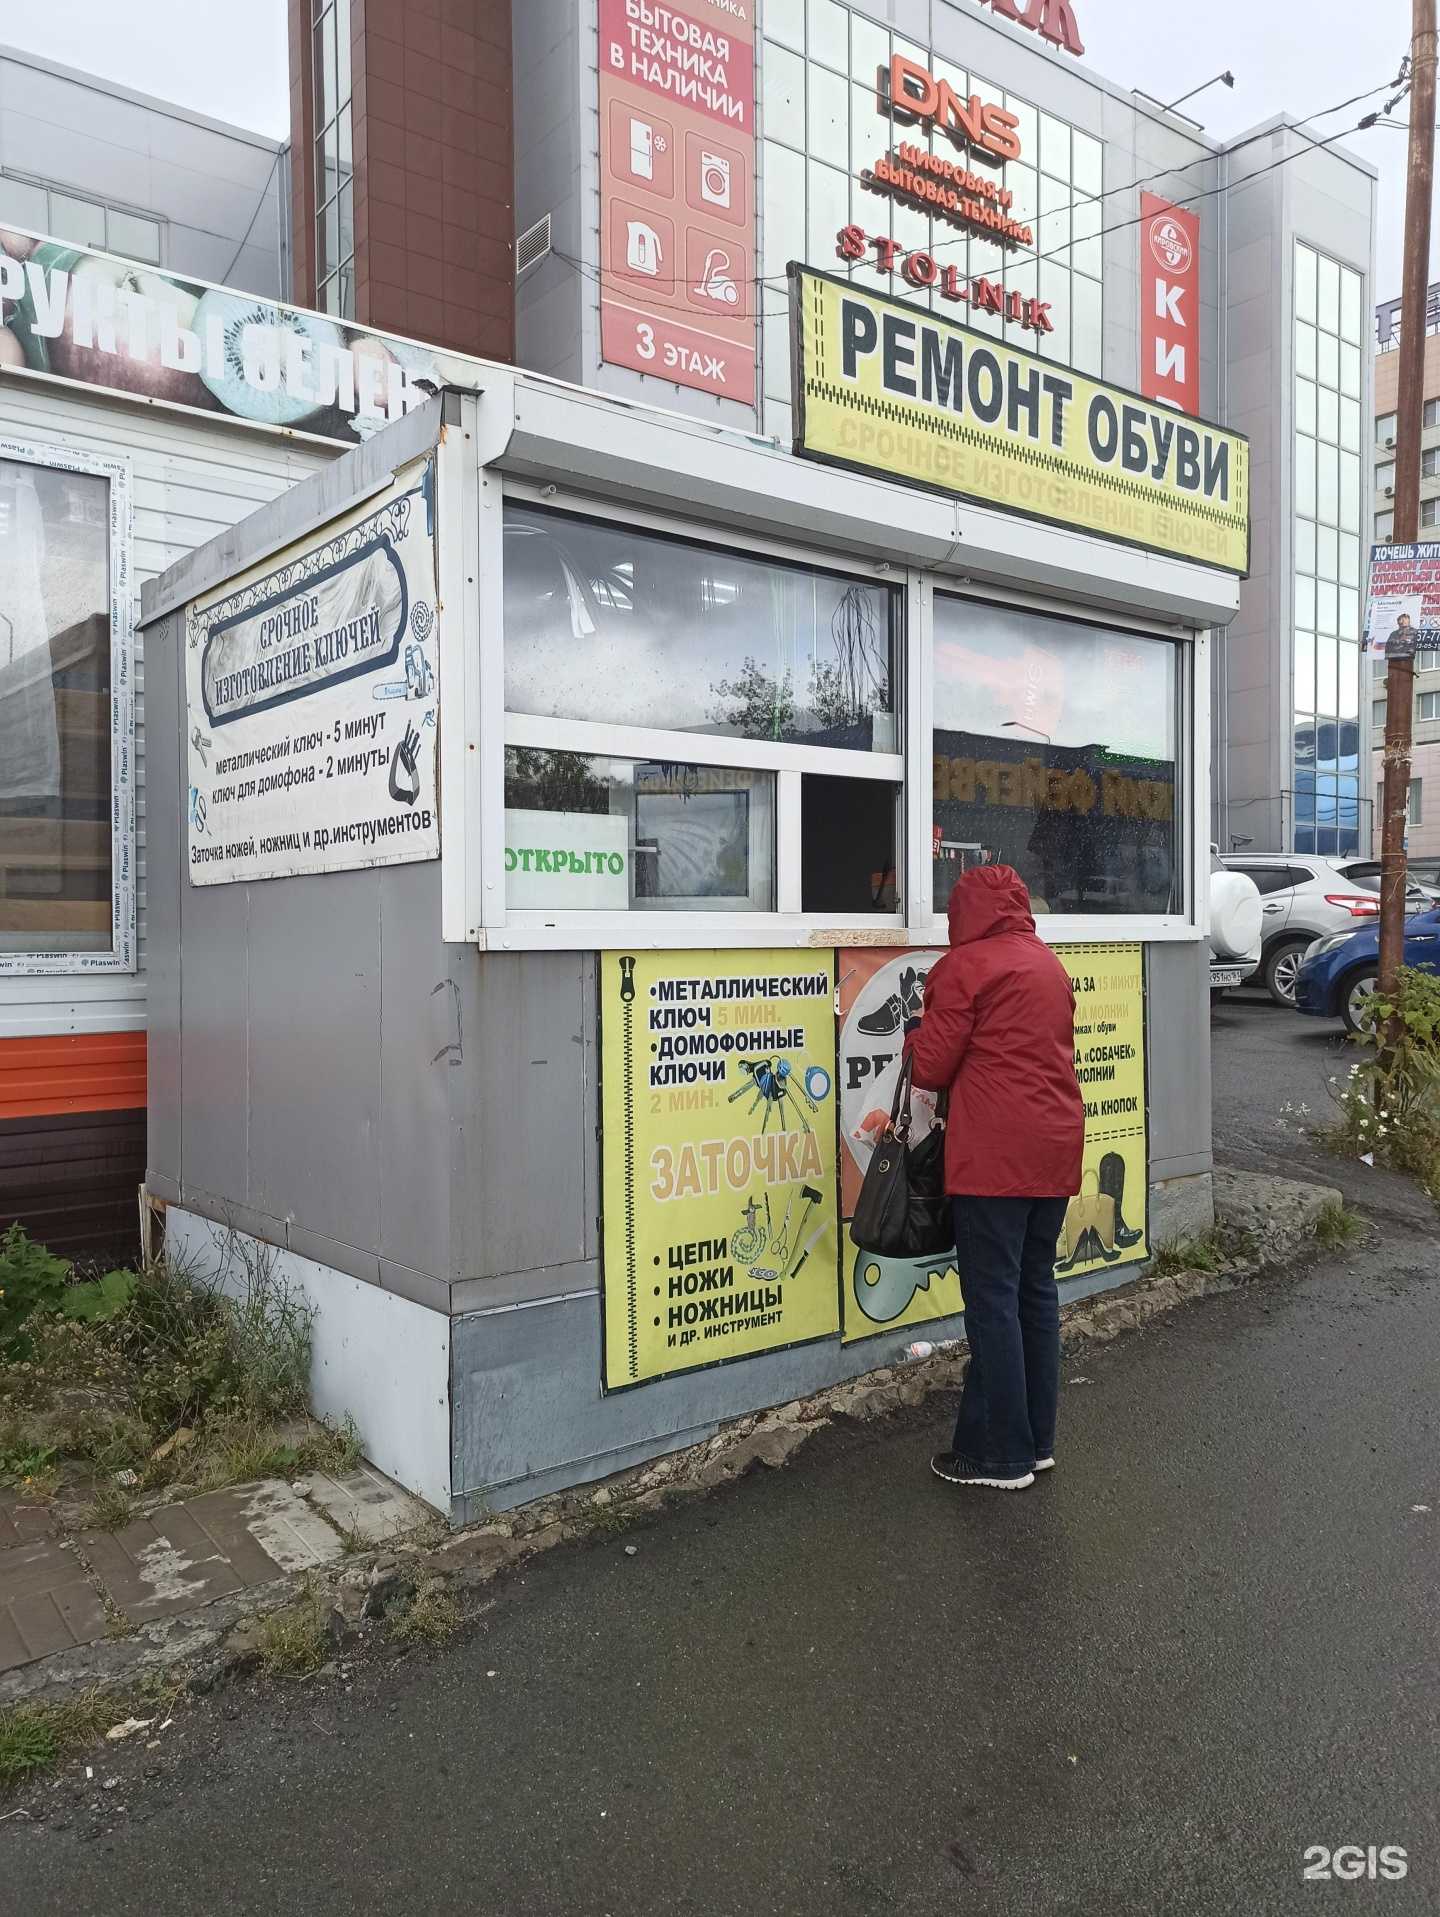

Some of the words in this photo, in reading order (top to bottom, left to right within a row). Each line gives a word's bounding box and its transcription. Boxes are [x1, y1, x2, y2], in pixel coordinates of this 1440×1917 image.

[707, 0, 746, 20] НИКА
[625, 0, 729, 62] БЫТОВАЯ
[627, 22, 728, 88] ТЕХНИКА
[610, 42, 625, 69] В
[632, 52, 743, 122] НАЛИЧИИ
[891, 53, 1022, 160] DNS
[899, 141, 996, 197] ЦИФРОВАЯ
[999, 186, 1012, 208] И
[875, 159, 958, 209] БЫТОВАЯ
[961, 197, 1033, 246] ТЕХНИКА
[839, 223, 1054, 332] STOLNIK
[636, 323, 656, 360] 3
[664, 342, 726, 383] ЭТАЖ
[1155, 277, 1187, 412] КИ
[842, 298, 1073, 448] РЕМОНТ
[1087, 394, 1229, 501] ОБУВИ
[836, 418, 965, 481] СРОЧНОЕ
[1374, 545, 1415, 560] ХОЧЕШЬ
[1416, 543, 1440, 558] ЖИТ
[259, 595, 319, 649] СРОЧНОЕ
[215, 644, 310, 706] ИЗГОТОВЛЕНИЕ
[314, 606, 382, 668] КЛЮЧЕЙ
[215, 736, 290, 775] металлический
[293, 731, 323, 755] ключ
[334, 720, 341, 743] 5
[345, 711, 386, 740] минут
[212, 785, 235, 805] ключ
[237, 780, 255, 802] для
[258, 765, 315, 796] домофона
[326, 755, 333, 779] 2
[337, 746, 390, 776] минуты
[191, 845, 224, 864] Заточка
[226, 836, 258, 860] ножей,
[260, 831, 301, 852] ножниц
[303, 831, 311, 848] и
[504, 847, 624, 876] ОТКРЫТО
[90, 959, 120, 967] Plaswin
[658, 972, 828, 1001] МЕТАЛЛИЧЕСКИЙ
[1083, 976, 1095, 992] ЗА
[1110, 973, 1140, 990] МИНУТ
[650, 1007, 711, 1030] КЛЮЧ
[717, 1007, 728, 1026] 5
[735, 1004, 781, 1025] МИН.
[1073, 1024, 1092, 1035] мках
[1097, 1021, 1116, 1036] обуви
[658, 1029, 804, 1061] ДОМОФОННЫЕ
[1085, 1043, 1136, 1063] «СОБАЧЕК»
[650, 1061, 726, 1086] КЛЮЧИ
[1076, 1065, 1115, 1084] МОЛНИИ
[650, 1094, 661, 1113] 2
[669, 1089, 719, 1112] МИН.
[1101, 1096, 1138, 1117] КНОПОК
[651, 1131, 823, 1200] ЗАТОЧКА
[668, 1238, 727, 1270] ЦЕПИ
[668, 1266, 734, 1298] НОЖИ
[668, 1285, 783, 1328] НОЖНИЦЫ
[667, 1333, 676, 1347] И
[680, 1329, 700, 1346] ДР.
[704, 1310, 783, 1339] ИНСТРУМЕНТ
